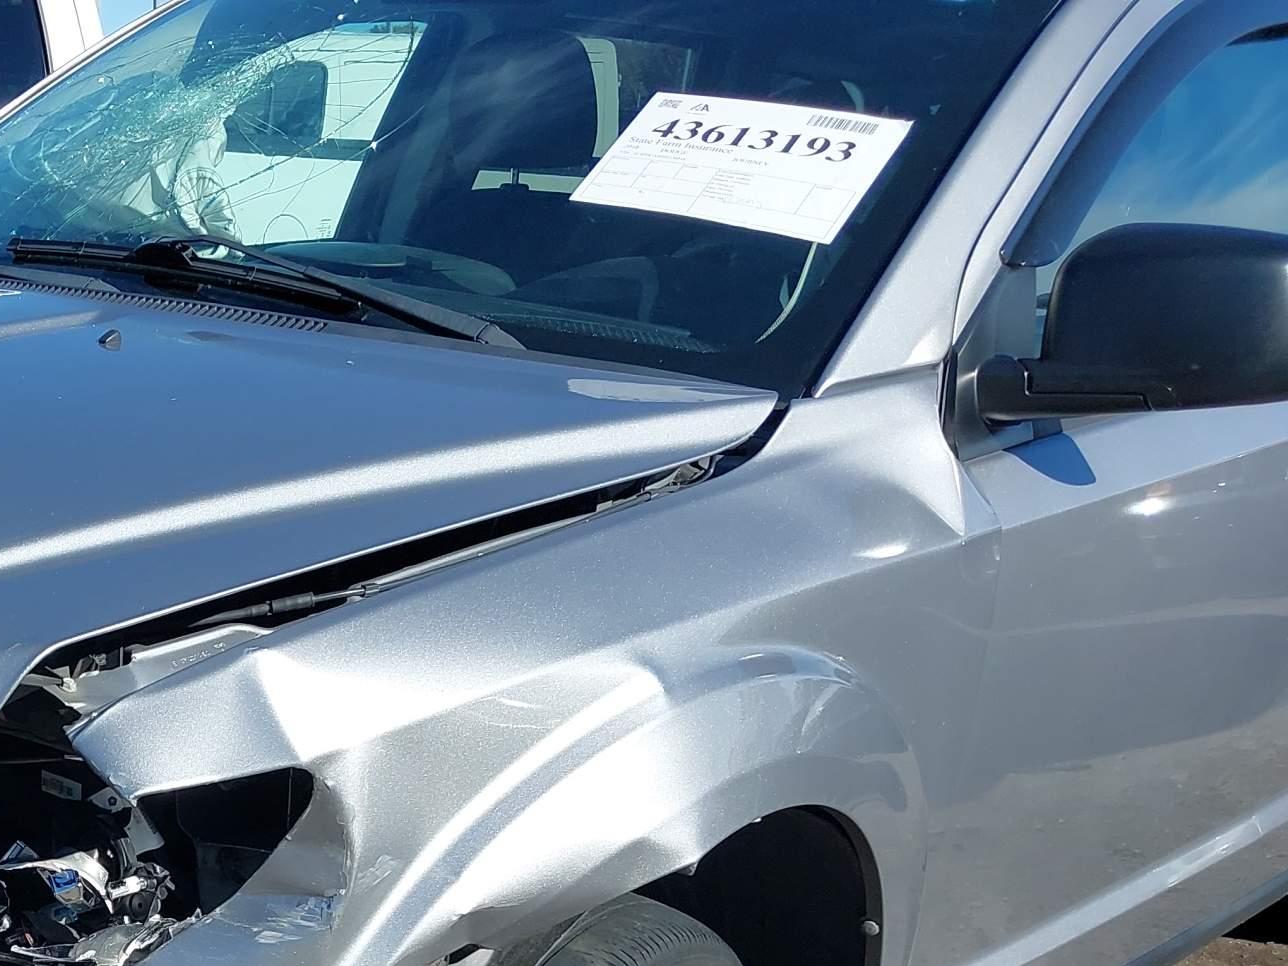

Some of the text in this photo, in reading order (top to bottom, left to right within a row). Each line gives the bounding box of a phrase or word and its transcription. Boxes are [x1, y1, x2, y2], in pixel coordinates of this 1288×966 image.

[629, 136, 734, 154] State Farm Insurance
[651, 118, 857, 163] 43613193
